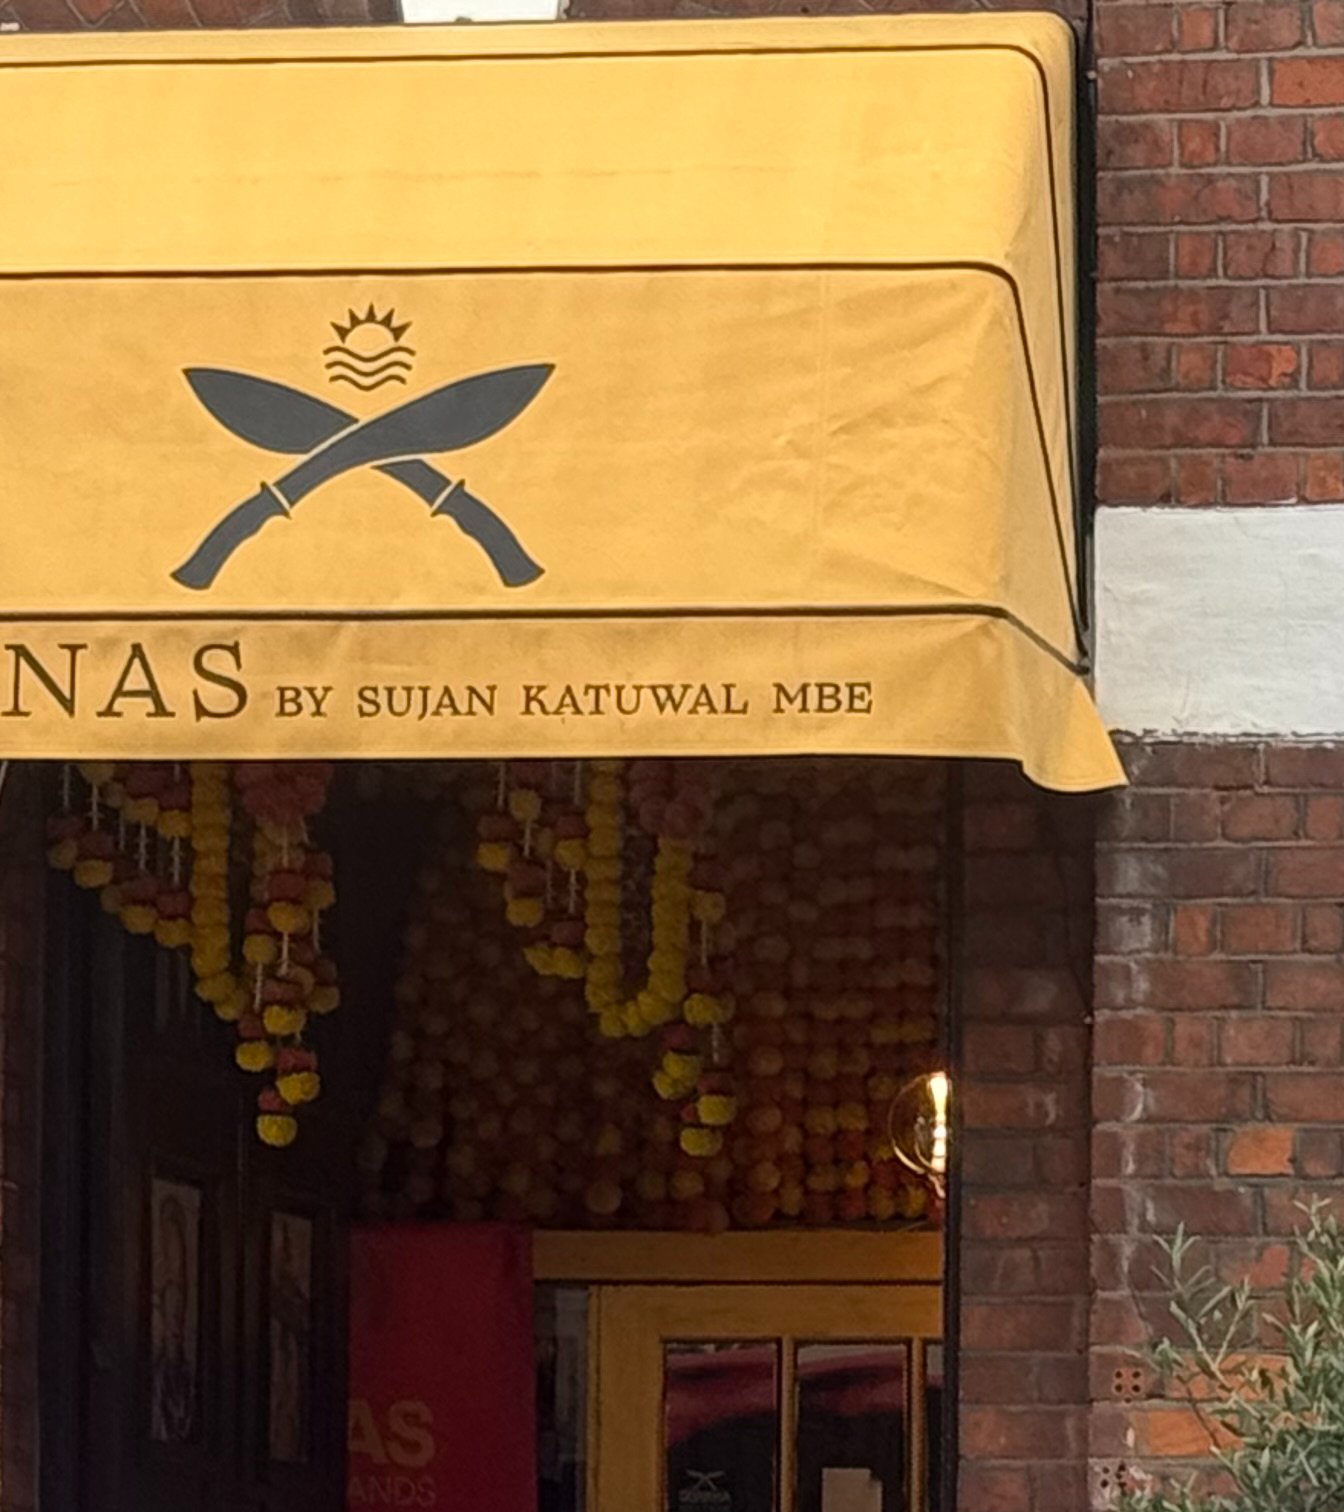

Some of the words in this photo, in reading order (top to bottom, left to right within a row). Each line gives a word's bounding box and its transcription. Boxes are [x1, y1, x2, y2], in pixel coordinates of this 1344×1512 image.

[275, 685, 331, 720] BY
[356, 683, 499, 721] SUJAN
[519, 683, 749, 719] KATUWAL
[771, 681, 874, 717] MBE
